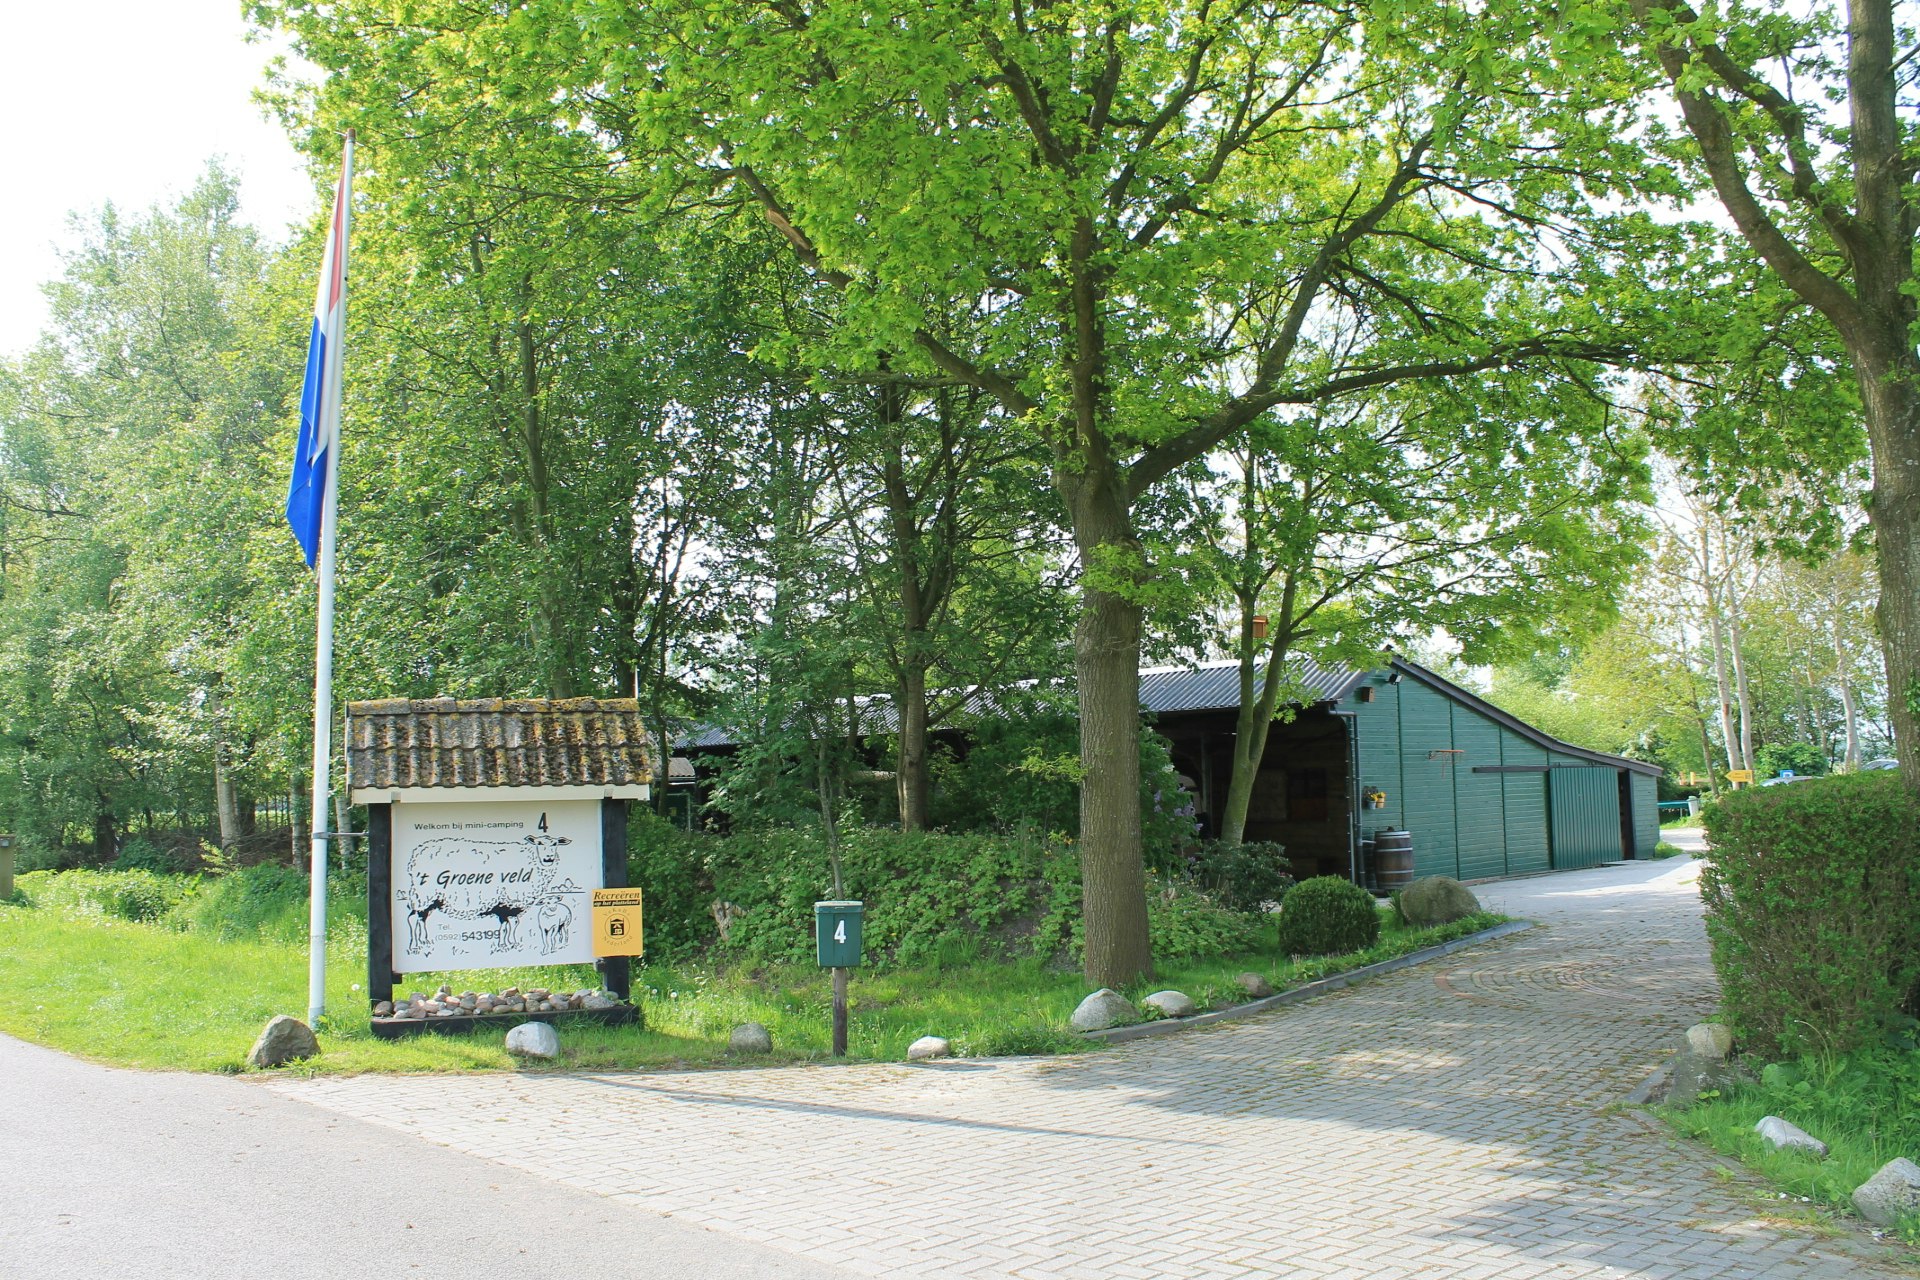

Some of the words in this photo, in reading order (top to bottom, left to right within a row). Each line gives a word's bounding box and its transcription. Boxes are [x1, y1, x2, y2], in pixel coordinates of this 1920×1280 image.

[414, 822, 450, 830] Welkom
[452, 822, 463, 831] bij
[465, 821, 524, 831] mini-camping
[537, 812, 549, 833] 4
[416, 871, 429, 885] 't
[436, 869, 493, 889] Groene
[501, 868, 534, 883] veld
[594, 891, 640, 900] Recreëren
[461, 929, 501, 942] 543199
[834, 920, 847, 944] 4
